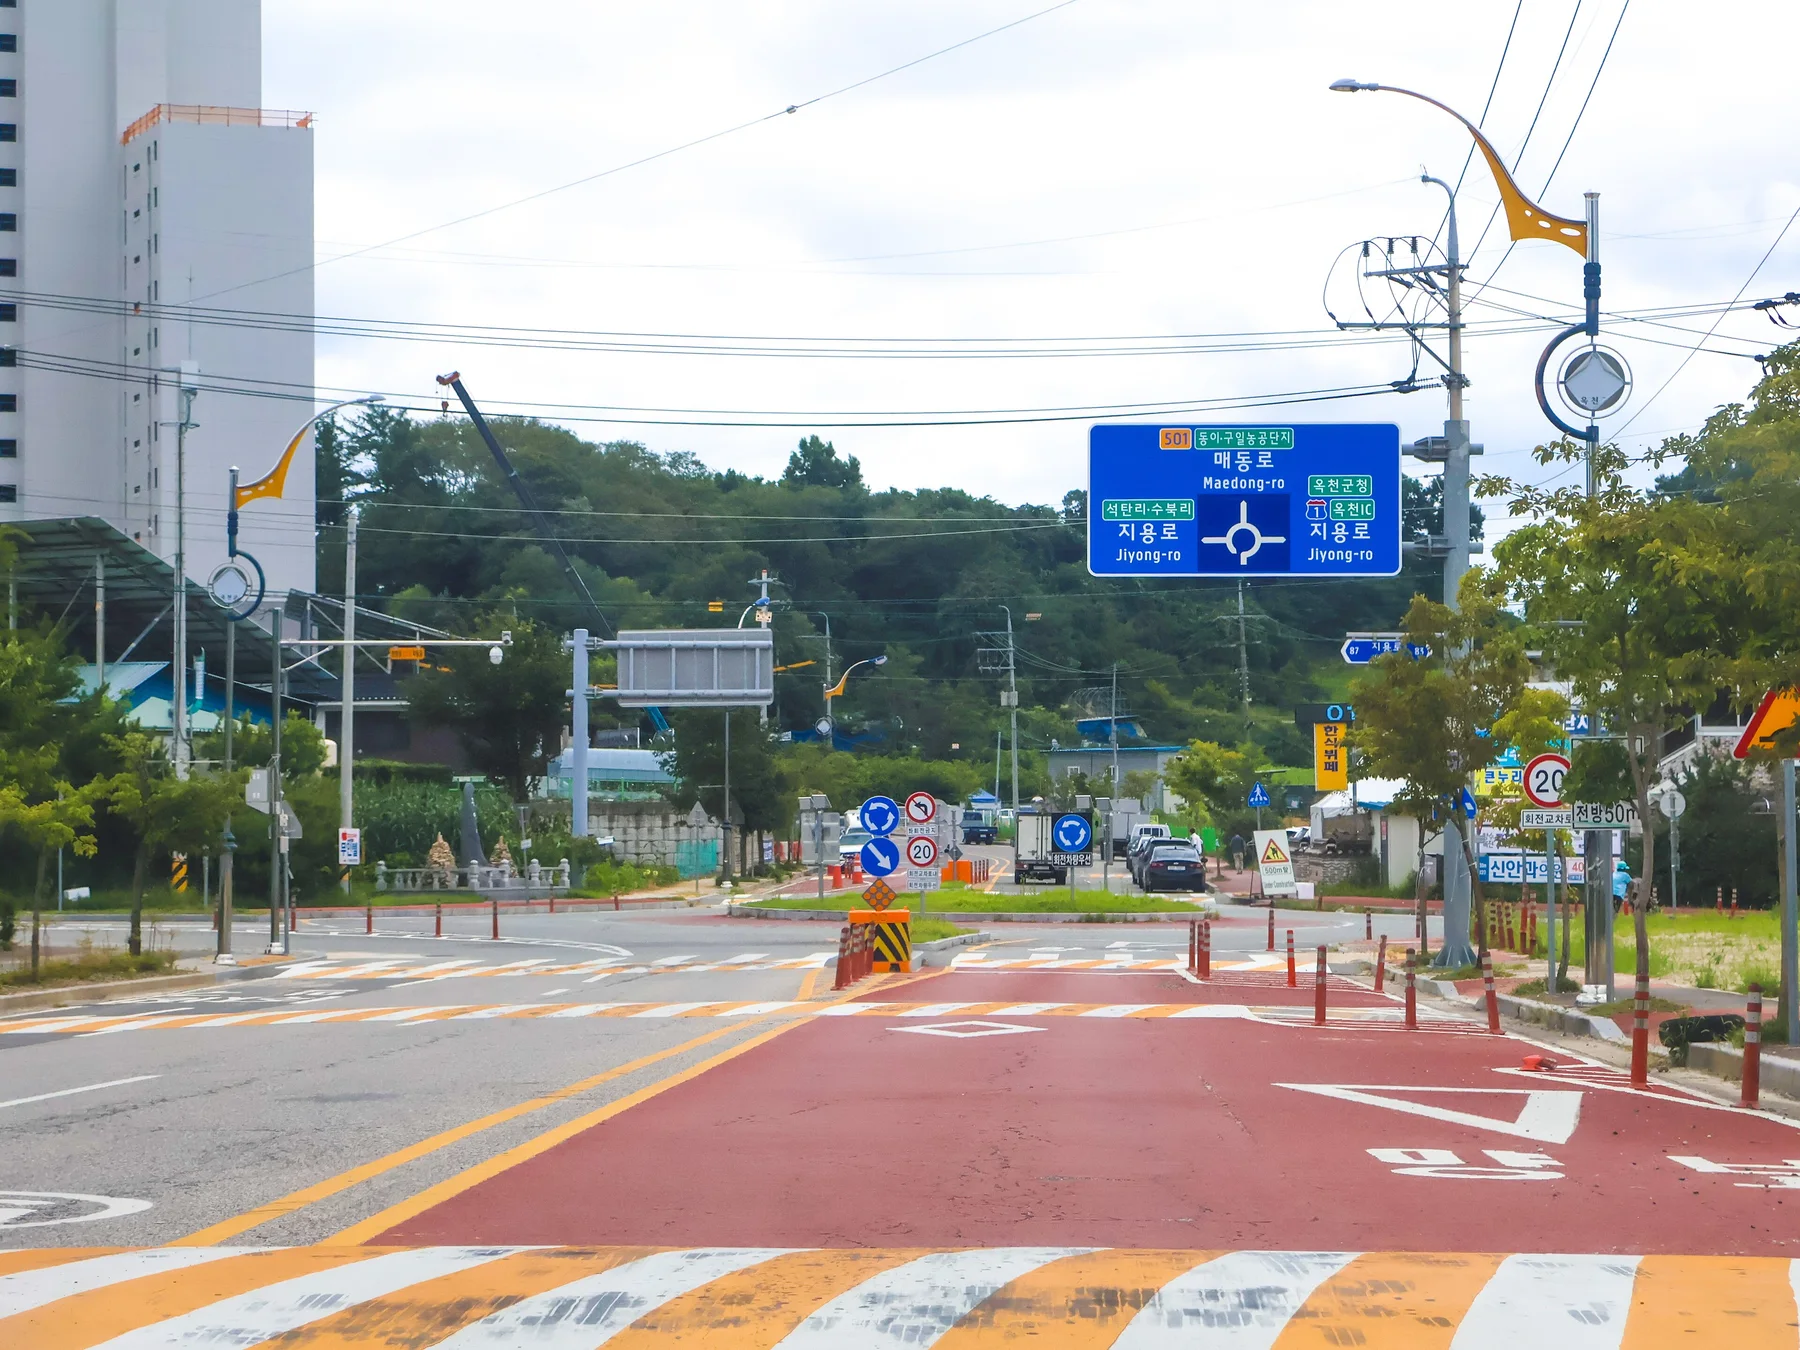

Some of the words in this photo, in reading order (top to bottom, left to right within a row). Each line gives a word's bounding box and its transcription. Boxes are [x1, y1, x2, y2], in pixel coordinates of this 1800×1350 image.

[1164, 432, 1188, 446] 501
[1214, 451, 1274, 473] 매동로
[1203, 476, 1285, 492] Maedong-ro
[1313, 478, 1368, 494] 옥천군청
[1106, 502, 1192, 518] 석탄리·수북리
[1332, 502, 1372, 517] 옥천IC
[1118, 523, 1179, 544] 지용로
[1310, 522, 1371, 544] 지용로
[1115, 548, 1181, 564] Jiyong-ro
[1308, 547, 1373, 563] Jiyong-ro
[1349, 646, 1359, 655] 87
[1323, 725, 1339, 772] 한식뷔페
[1535, 769, 1566, 793] 20
[913, 844, 931, 859] 20
[1053, 853, 1091, 866] 회전차량우선
